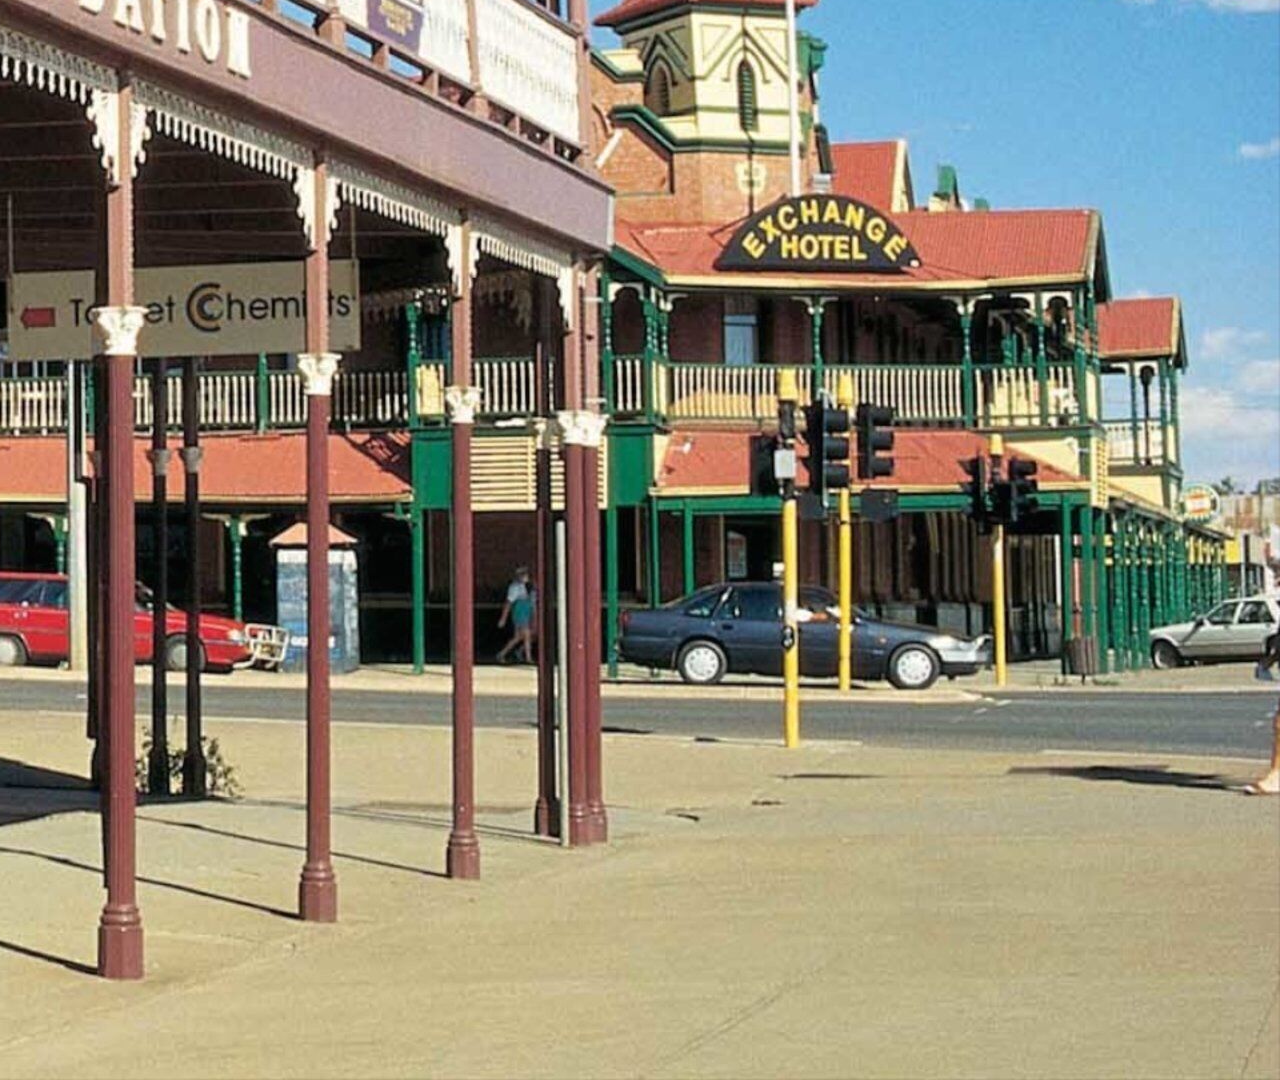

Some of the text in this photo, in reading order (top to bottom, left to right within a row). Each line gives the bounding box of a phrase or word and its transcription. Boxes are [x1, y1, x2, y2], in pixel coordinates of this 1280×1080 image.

[741, 199, 909, 262] EXCHANGE
[779, 233, 868, 260] HOTEL
[186, 282, 352, 333] Chemits
